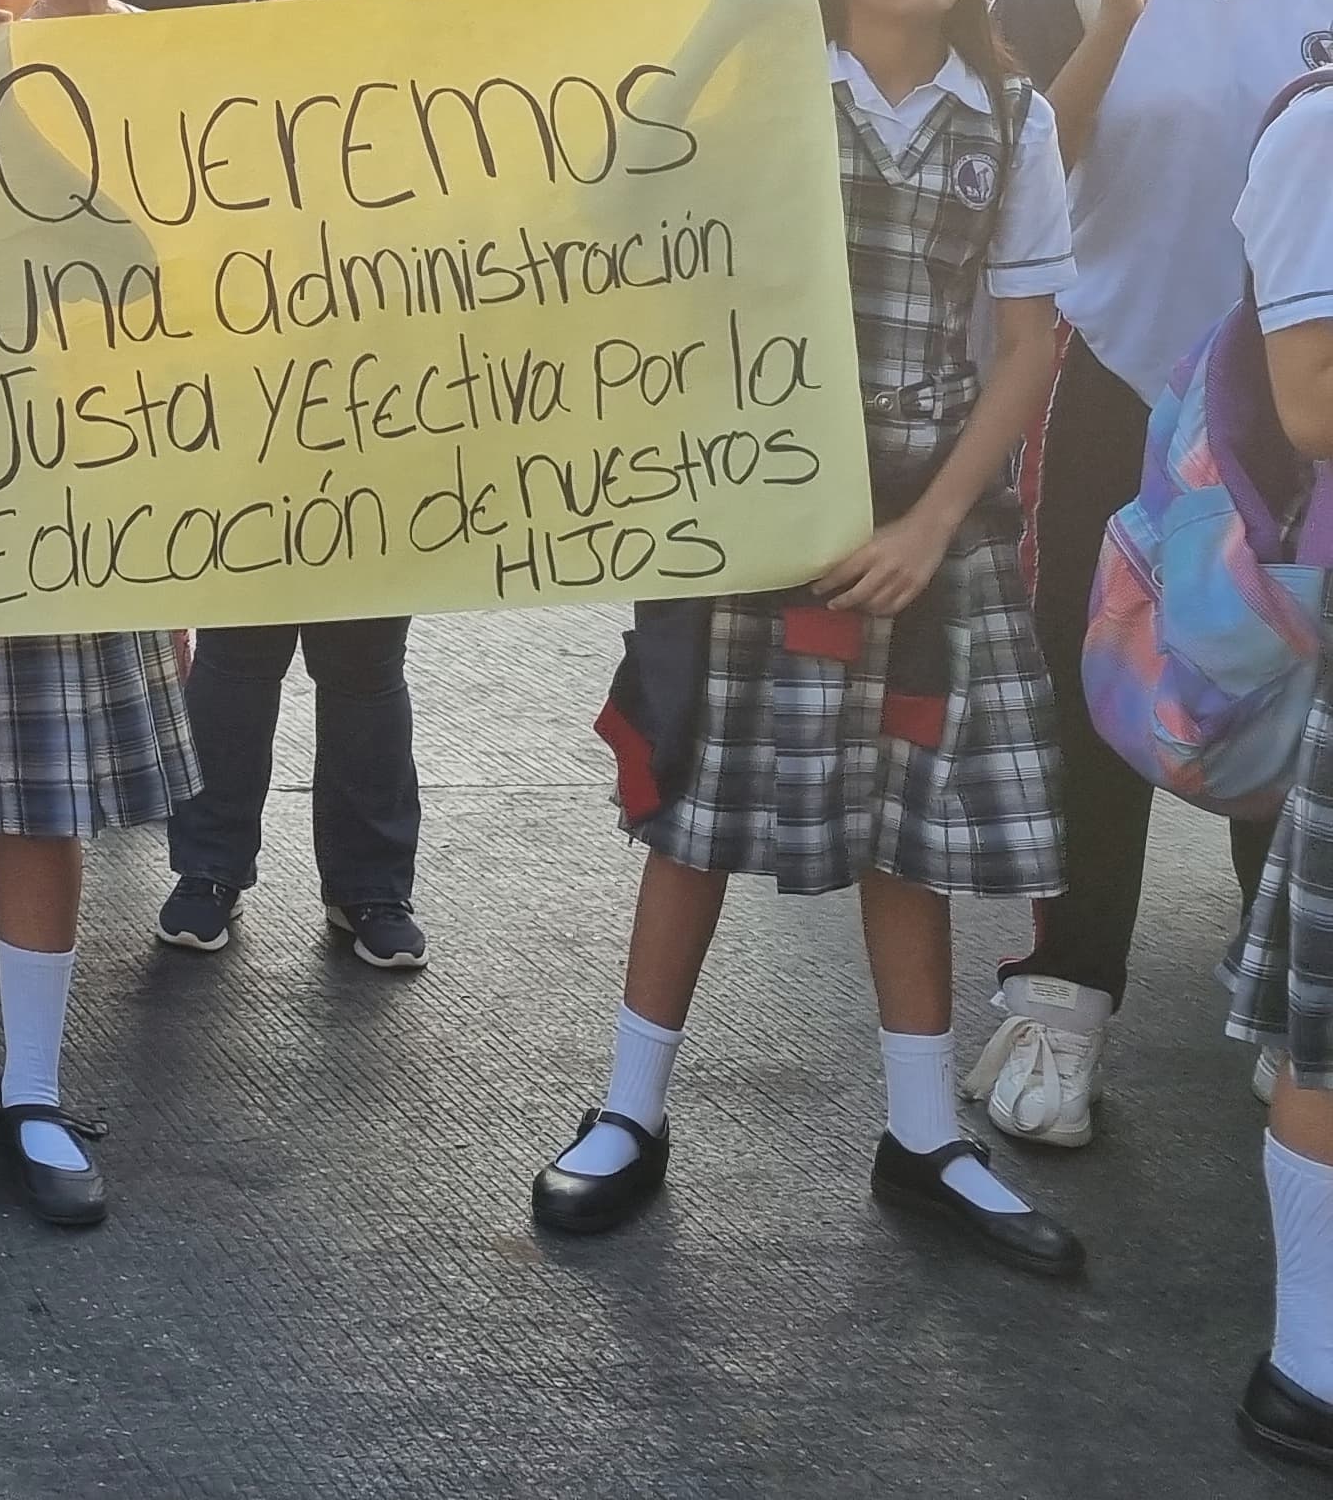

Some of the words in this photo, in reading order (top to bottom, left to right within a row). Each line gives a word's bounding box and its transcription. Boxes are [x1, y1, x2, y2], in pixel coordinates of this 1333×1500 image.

[215, 210, 734, 335] administración
[729, 308, 822, 410] la
[495, 518, 726, 599] HIJOS
